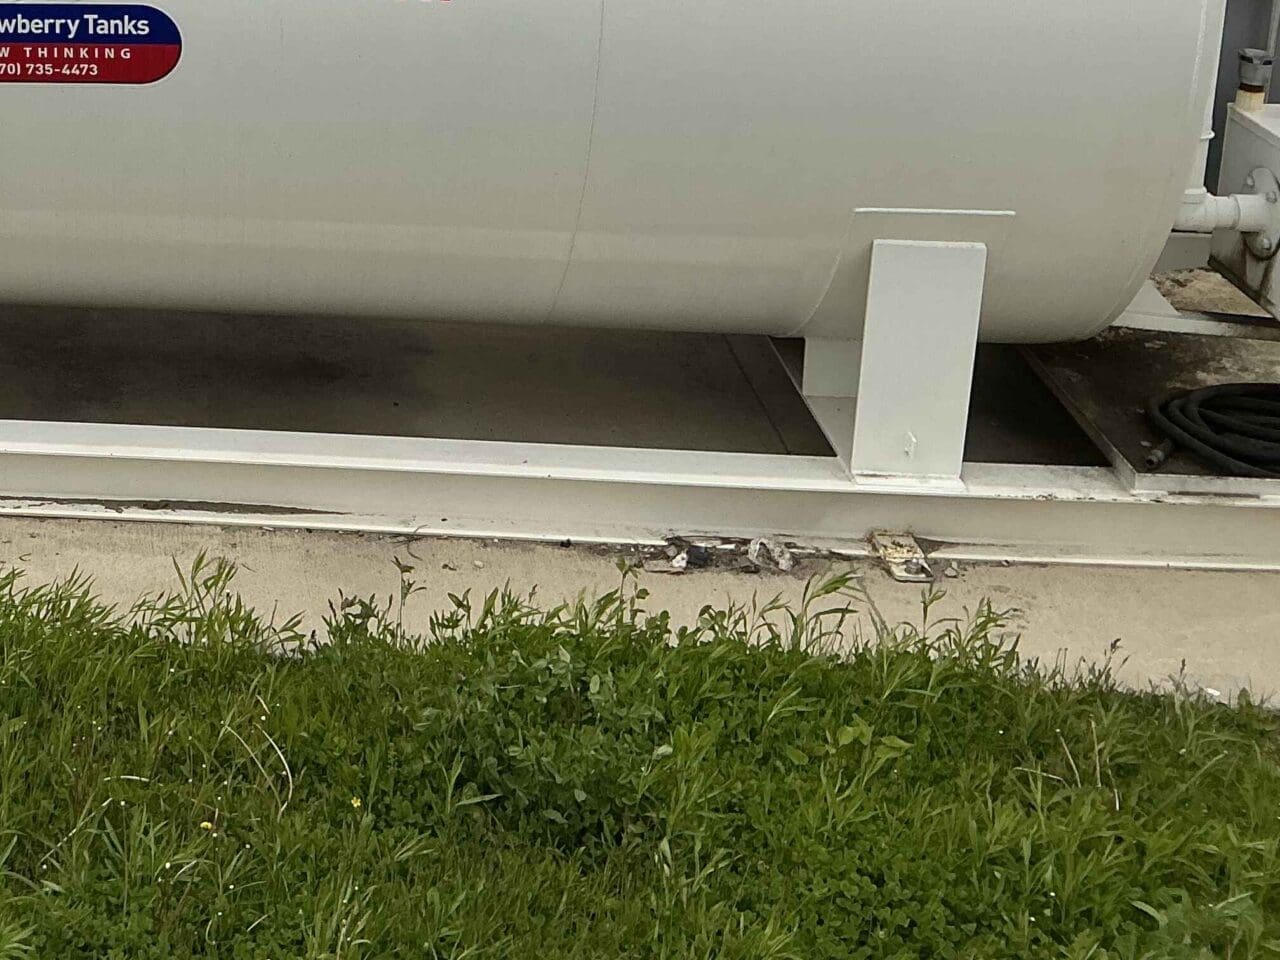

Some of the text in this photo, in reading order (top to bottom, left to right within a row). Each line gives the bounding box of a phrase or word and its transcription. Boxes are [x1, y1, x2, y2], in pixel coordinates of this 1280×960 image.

[83, 14, 150, 35] Tanks
[23, 47, 131, 59] THINKING
[25, 63, 99, 76] 735-4473
